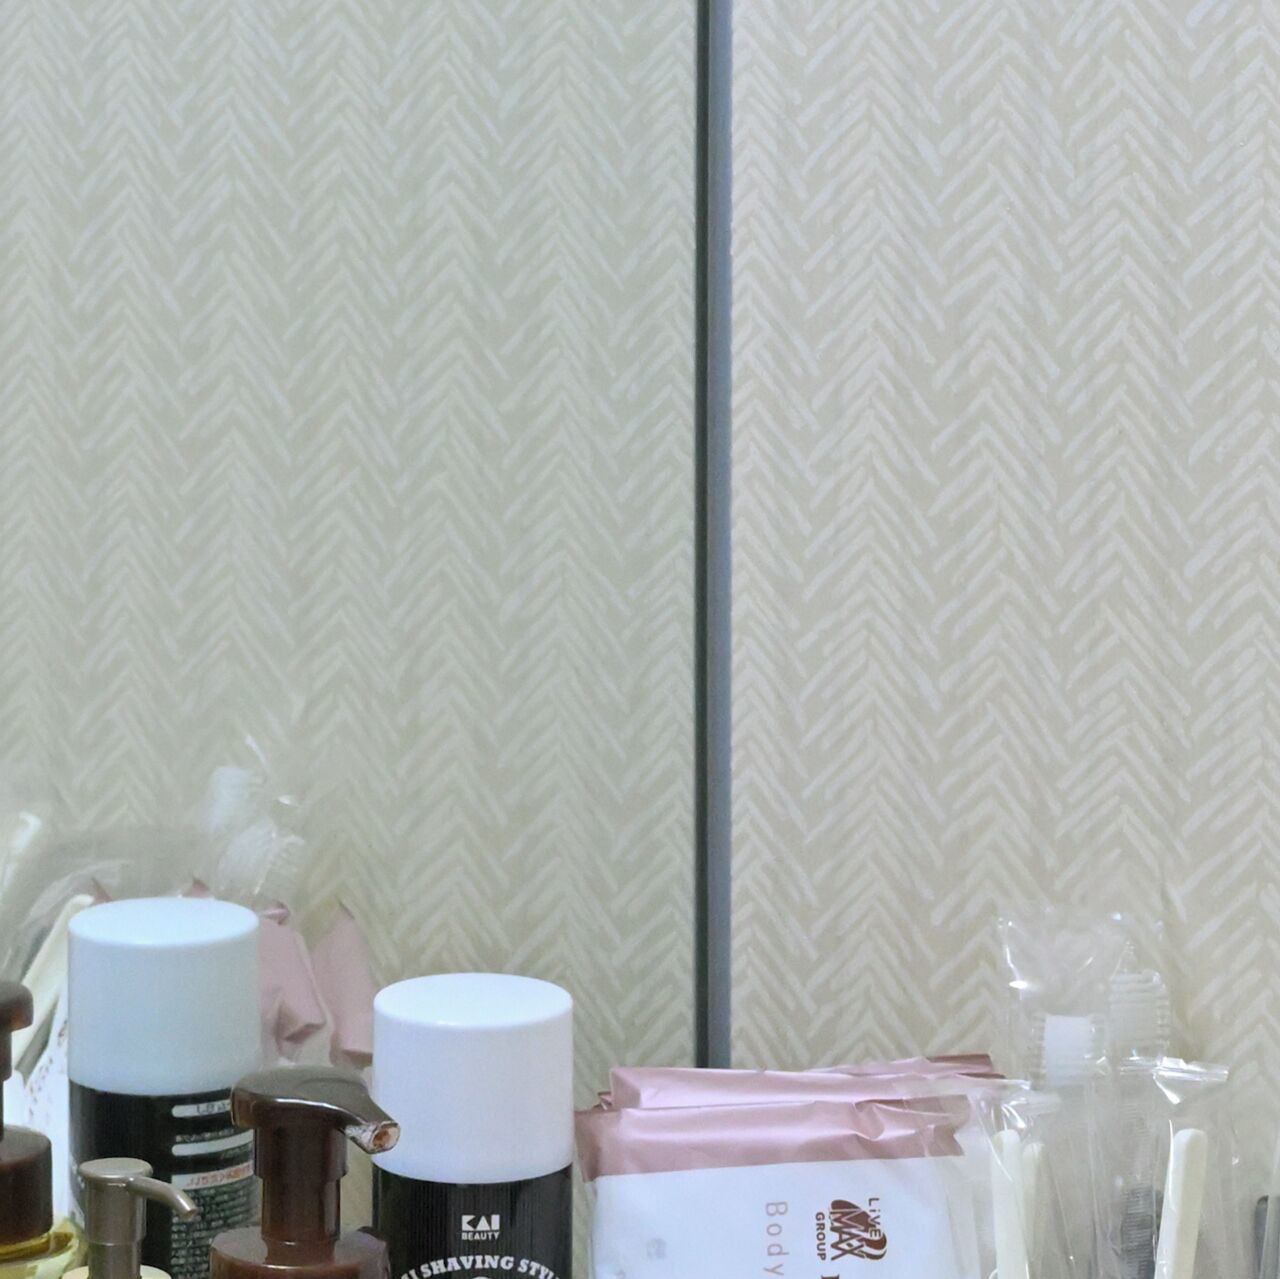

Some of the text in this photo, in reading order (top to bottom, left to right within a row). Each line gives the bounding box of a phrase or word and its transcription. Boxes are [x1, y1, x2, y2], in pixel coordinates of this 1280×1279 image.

[461, 1214, 501, 1231] KAI
[461, 1231, 500, 1241] BEAUTY
[763, 1201, 790, 1277] Body
[815, 1212, 827, 1261] GROUP
[420, 1254, 515, 1279] SHAVING
